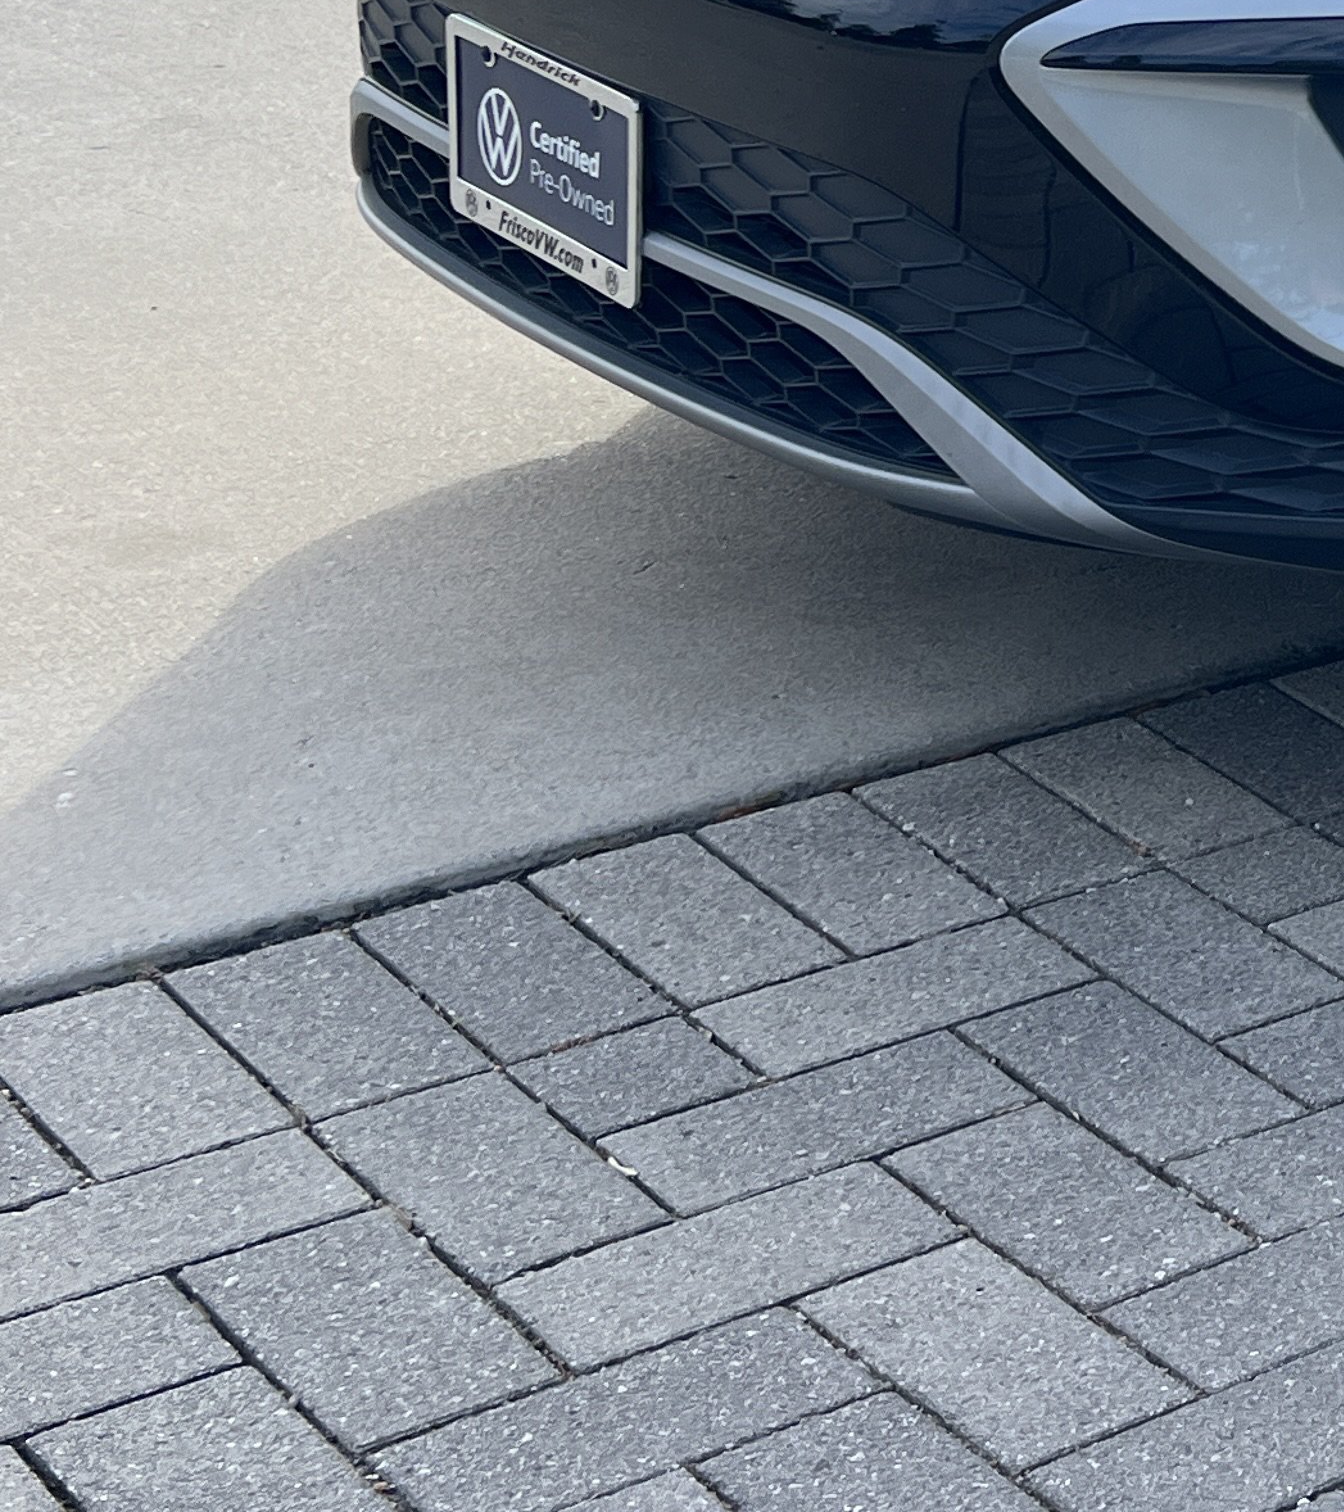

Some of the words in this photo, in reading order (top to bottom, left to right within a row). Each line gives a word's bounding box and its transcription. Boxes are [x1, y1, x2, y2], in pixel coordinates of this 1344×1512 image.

[500, 41, 582, 86] Hendrick
[529, 121, 601, 179] Certified
[529, 158, 615, 226] Pre-Owned
[498, 210, 585, 274] FriscoVW.com
